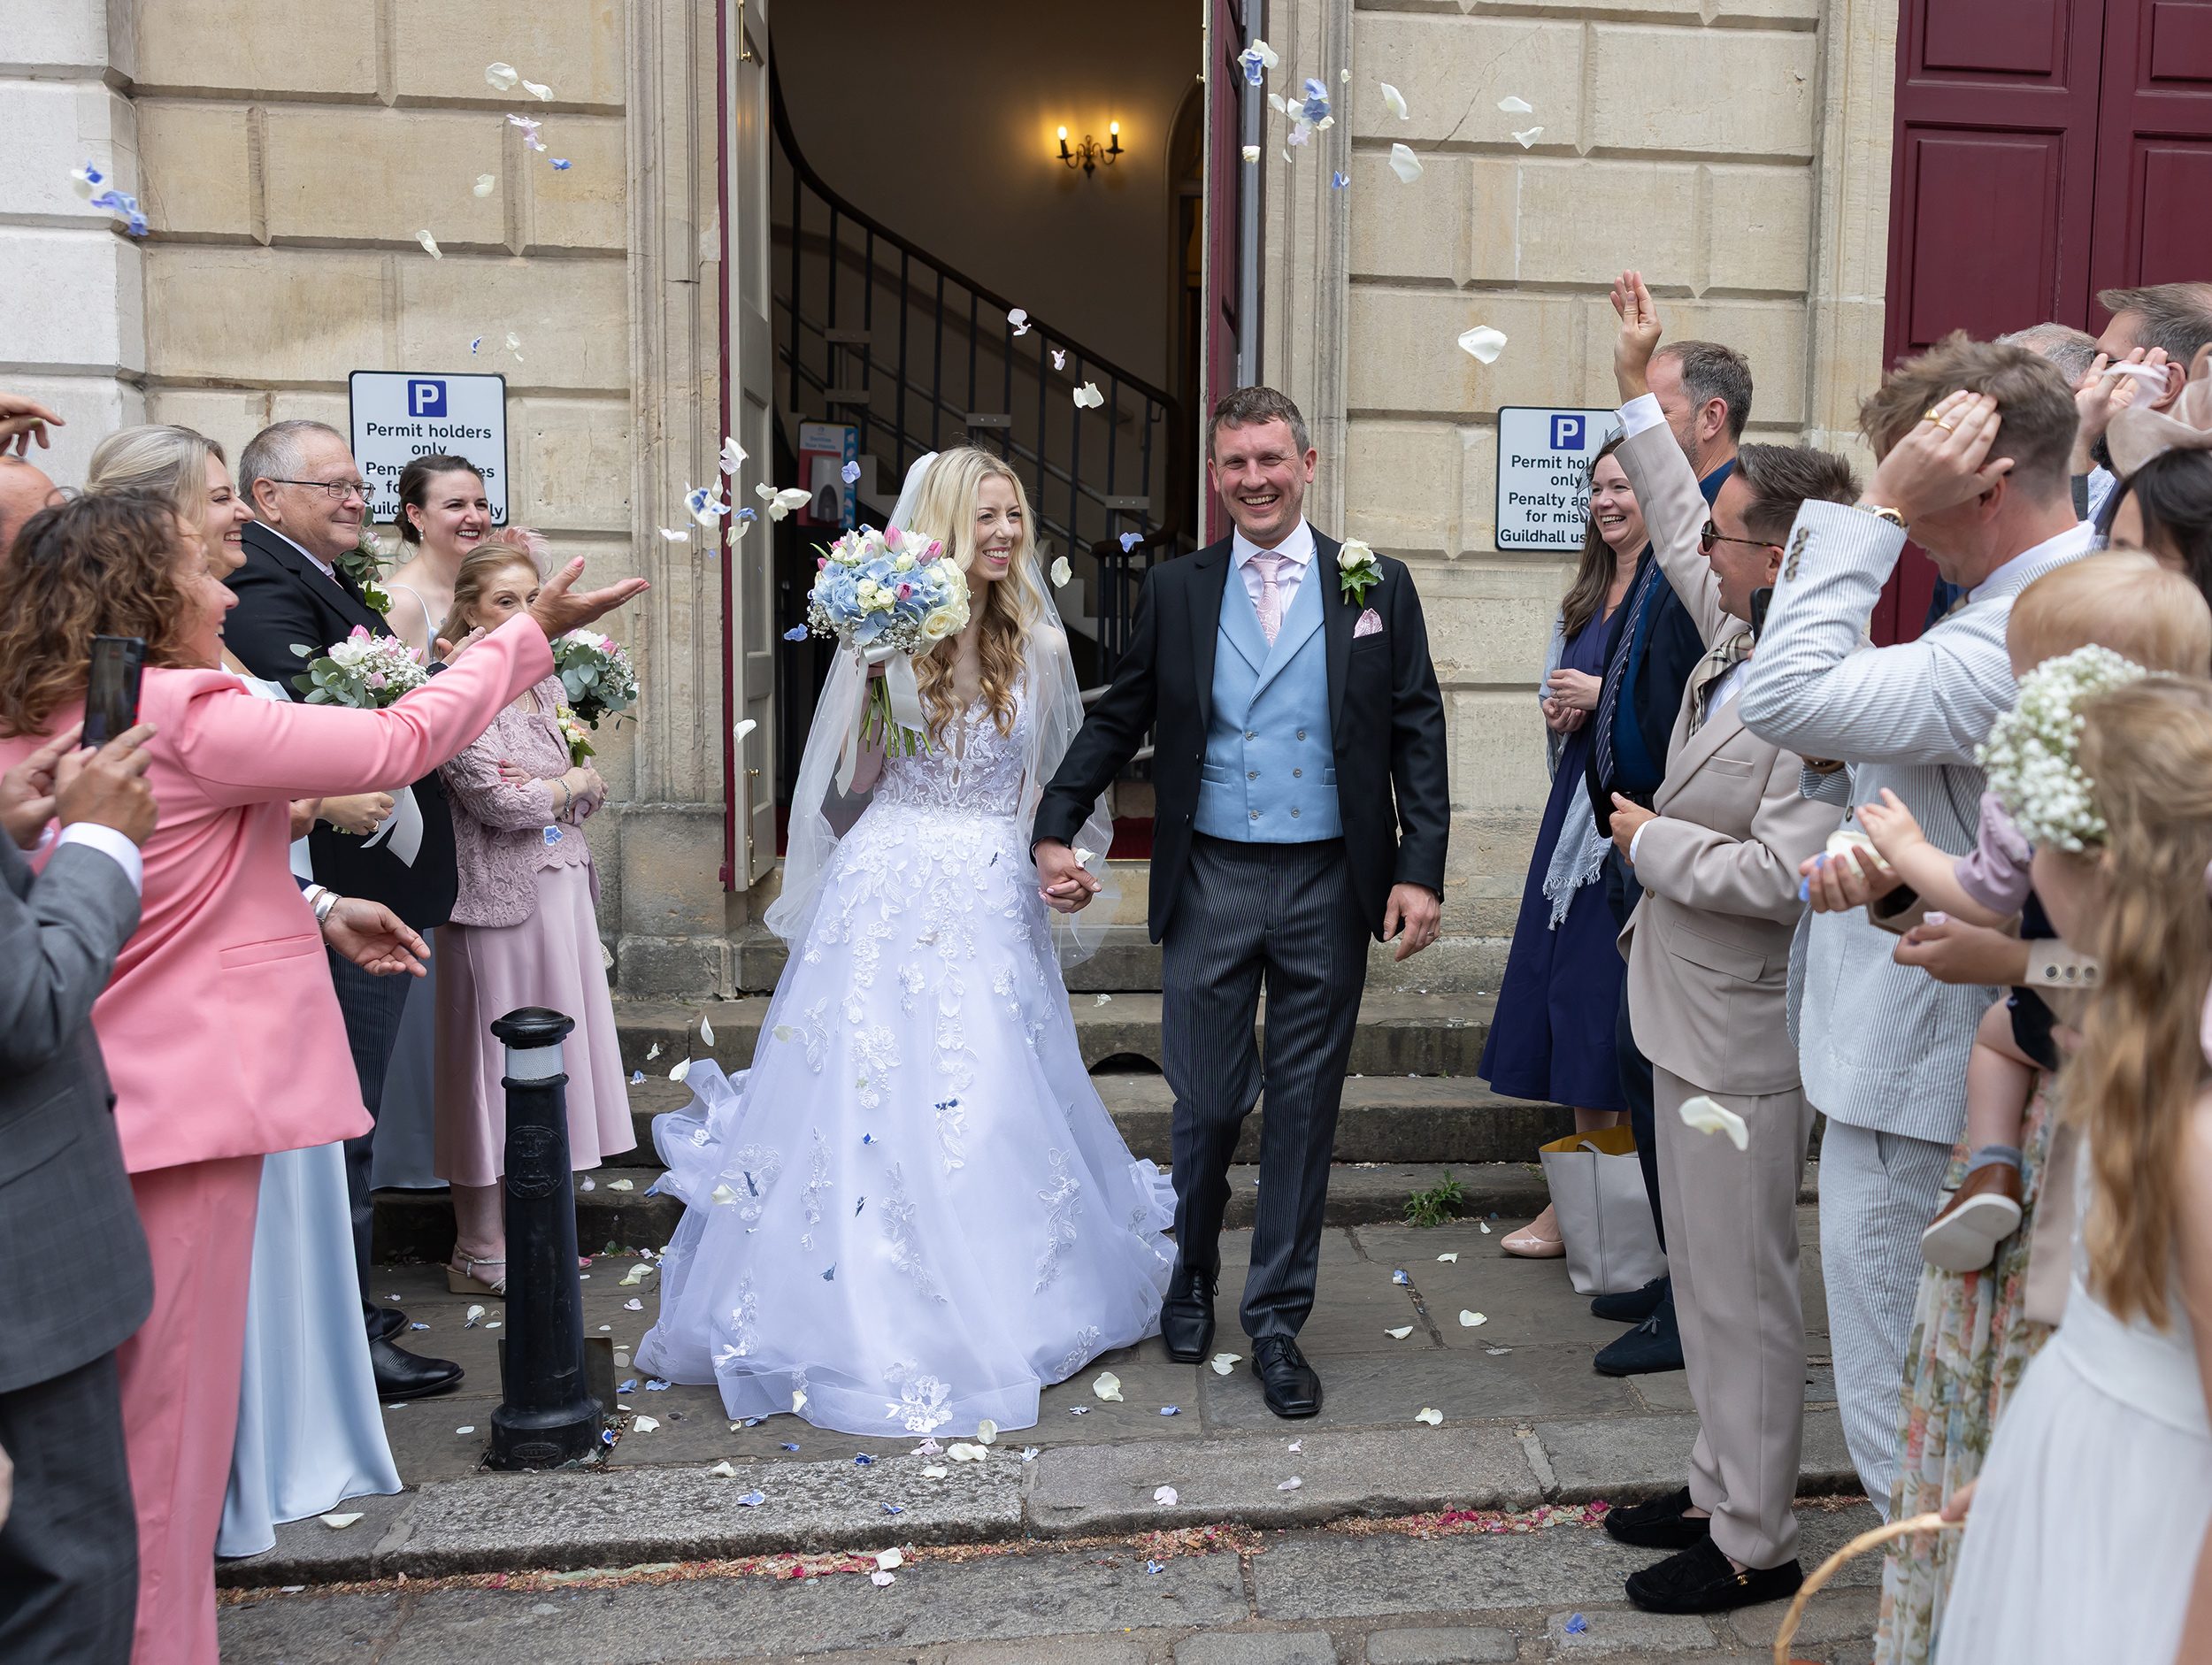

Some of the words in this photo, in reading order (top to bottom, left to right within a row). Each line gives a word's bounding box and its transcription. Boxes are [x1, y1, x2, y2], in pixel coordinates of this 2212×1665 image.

[415, 383, 439, 414] P
[366, 422, 423, 438] Permit
[429, 424, 492, 439] holders
[1556, 418, 1578, 447] P
[411, 442, 447, 455] only
[365, 462, 405, 475] Pena
[1511, 455, 1563, 469] Permit
[386, 480, 399, 494] fo
[1550, 473, 1583, 488] only
[1509, 492, 1565, 509] Penalty
[1525, 510, 1548, 523] for
[1553, 510, 1587, 523] misu
[1500, 529, 1566, 543] Guildhall
